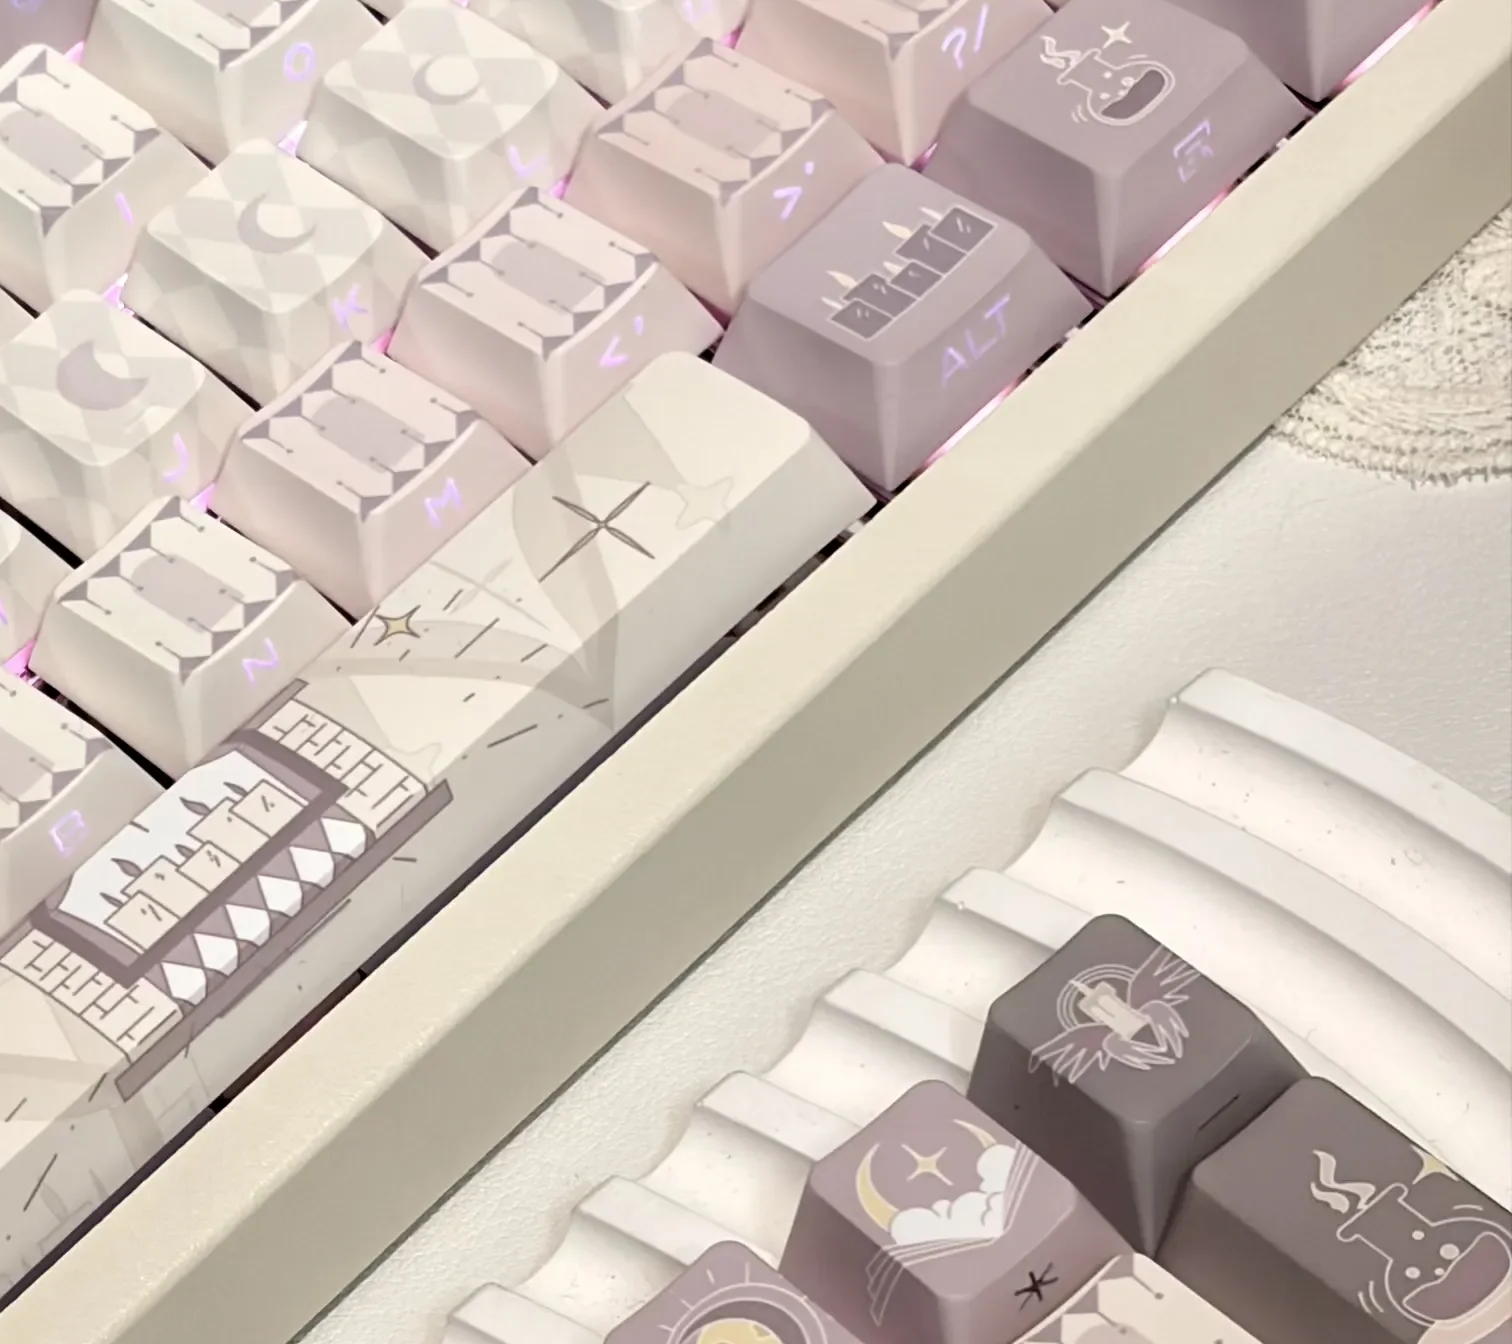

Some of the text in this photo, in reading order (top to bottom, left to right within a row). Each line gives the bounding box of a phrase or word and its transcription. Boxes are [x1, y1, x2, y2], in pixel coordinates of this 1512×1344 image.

[331, 282, 369, 331] K
[939, 292, 1013, 387] ALT
[162, 431, 190, 483] J
[424, 476, 462, 530] M
[241, 637, 278, 683] N
[49, 809, 86, 857] B
